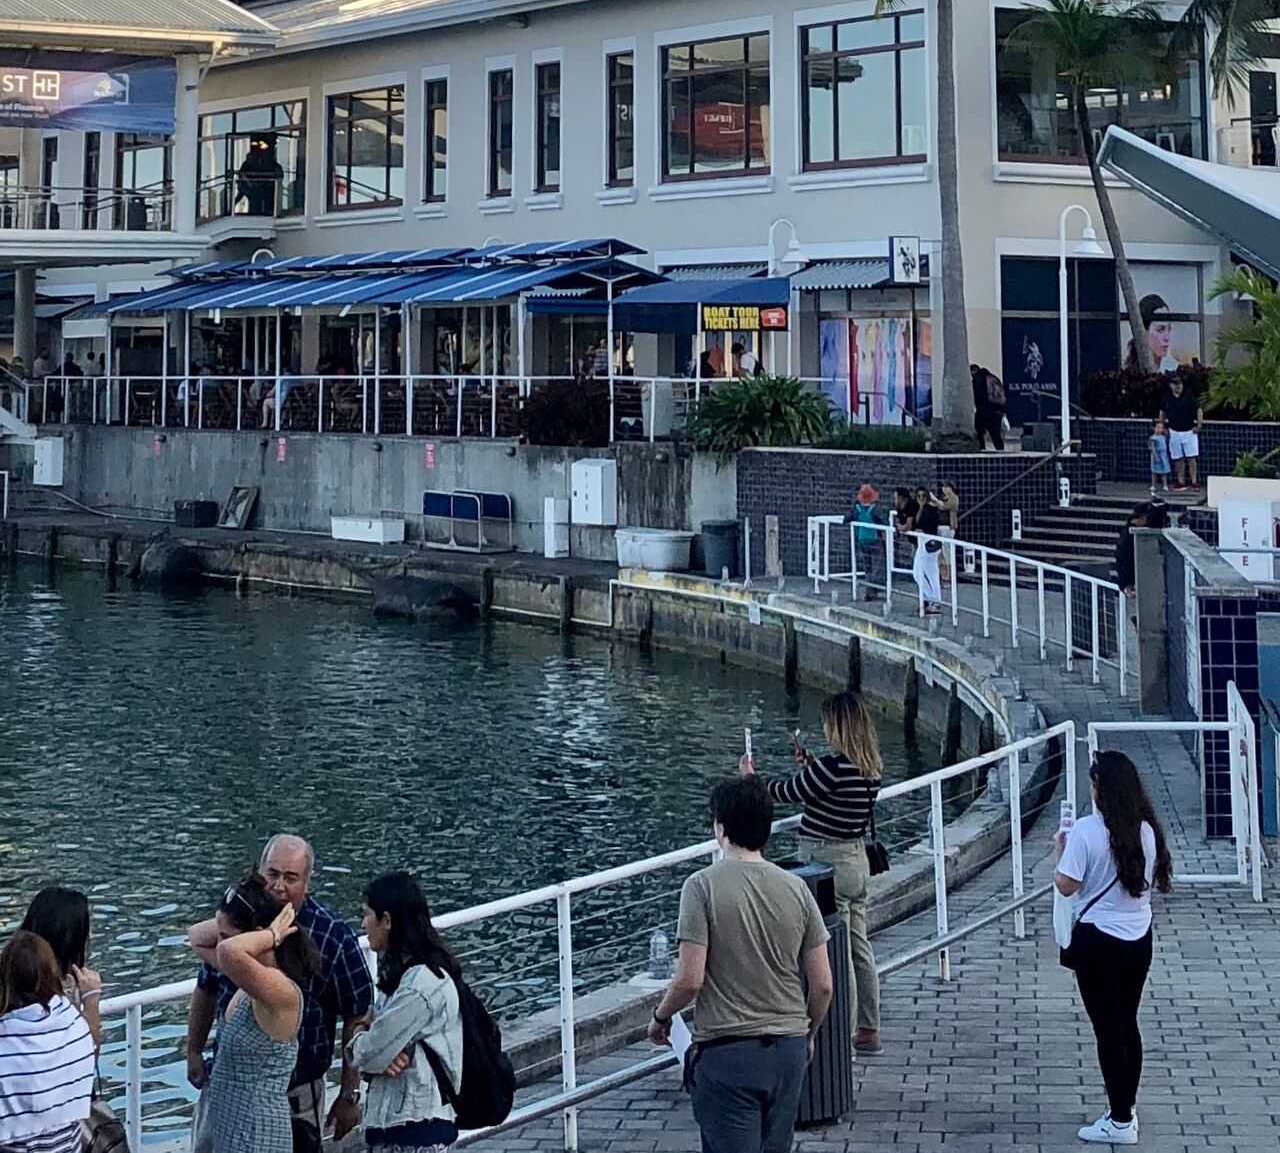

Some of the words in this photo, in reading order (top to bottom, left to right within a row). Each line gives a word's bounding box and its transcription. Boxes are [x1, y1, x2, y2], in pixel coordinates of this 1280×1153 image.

[703, 306, 731, 318] BOAT
[732, 306, 759, 318] TOUR
[704, 317, 739, 330] TICKETS
[739, 317, 760, 330] HERE
